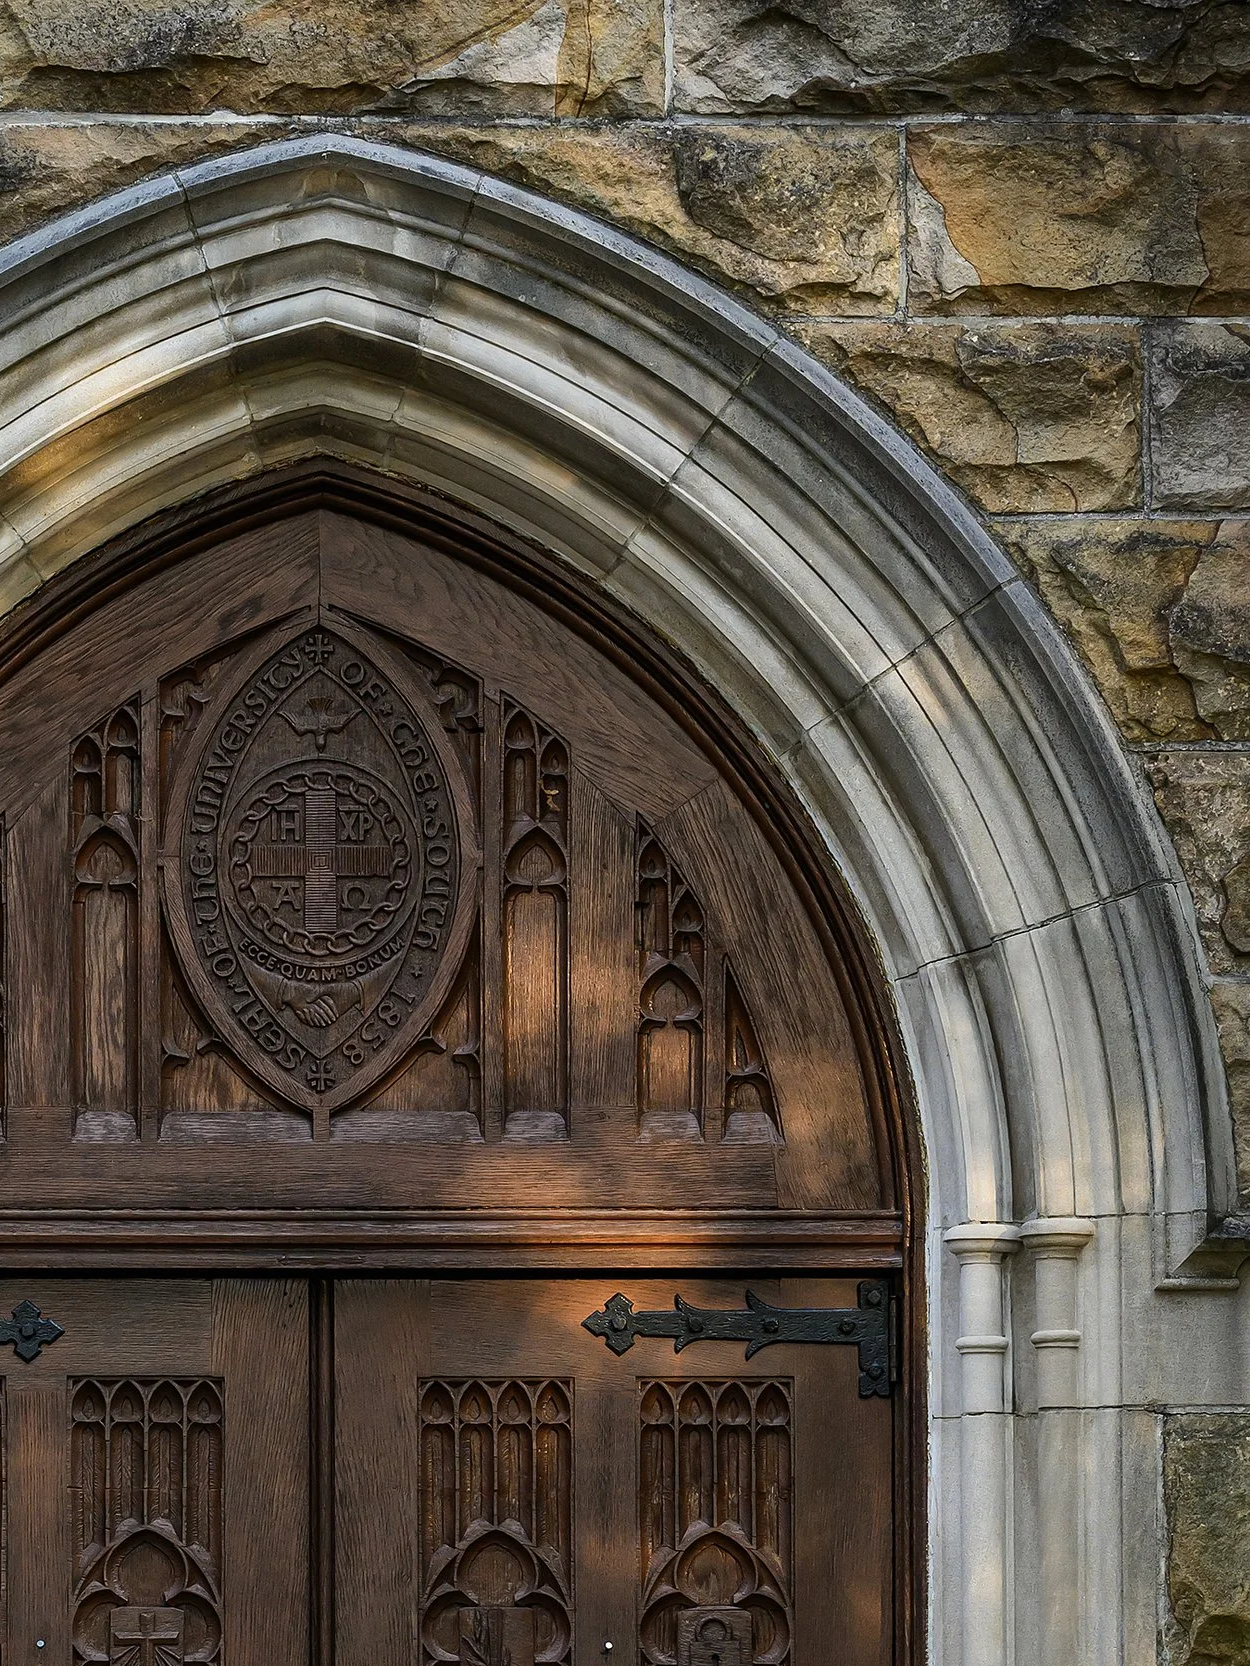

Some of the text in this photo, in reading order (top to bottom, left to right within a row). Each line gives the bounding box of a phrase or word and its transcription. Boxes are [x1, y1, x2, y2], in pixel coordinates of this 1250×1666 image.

[339, 660, 389, 701] OF
[191, 646, 305, 834] UNIVERSITY
[411, 815, 451, 951] SOUTH
[200, 934, 238, 978] OF
[237, 935, 407, 982] ECCE QUAM BONUM
[231, 983, 307, 1069] SEAL
[341, 986, 417, 1066] 1858
